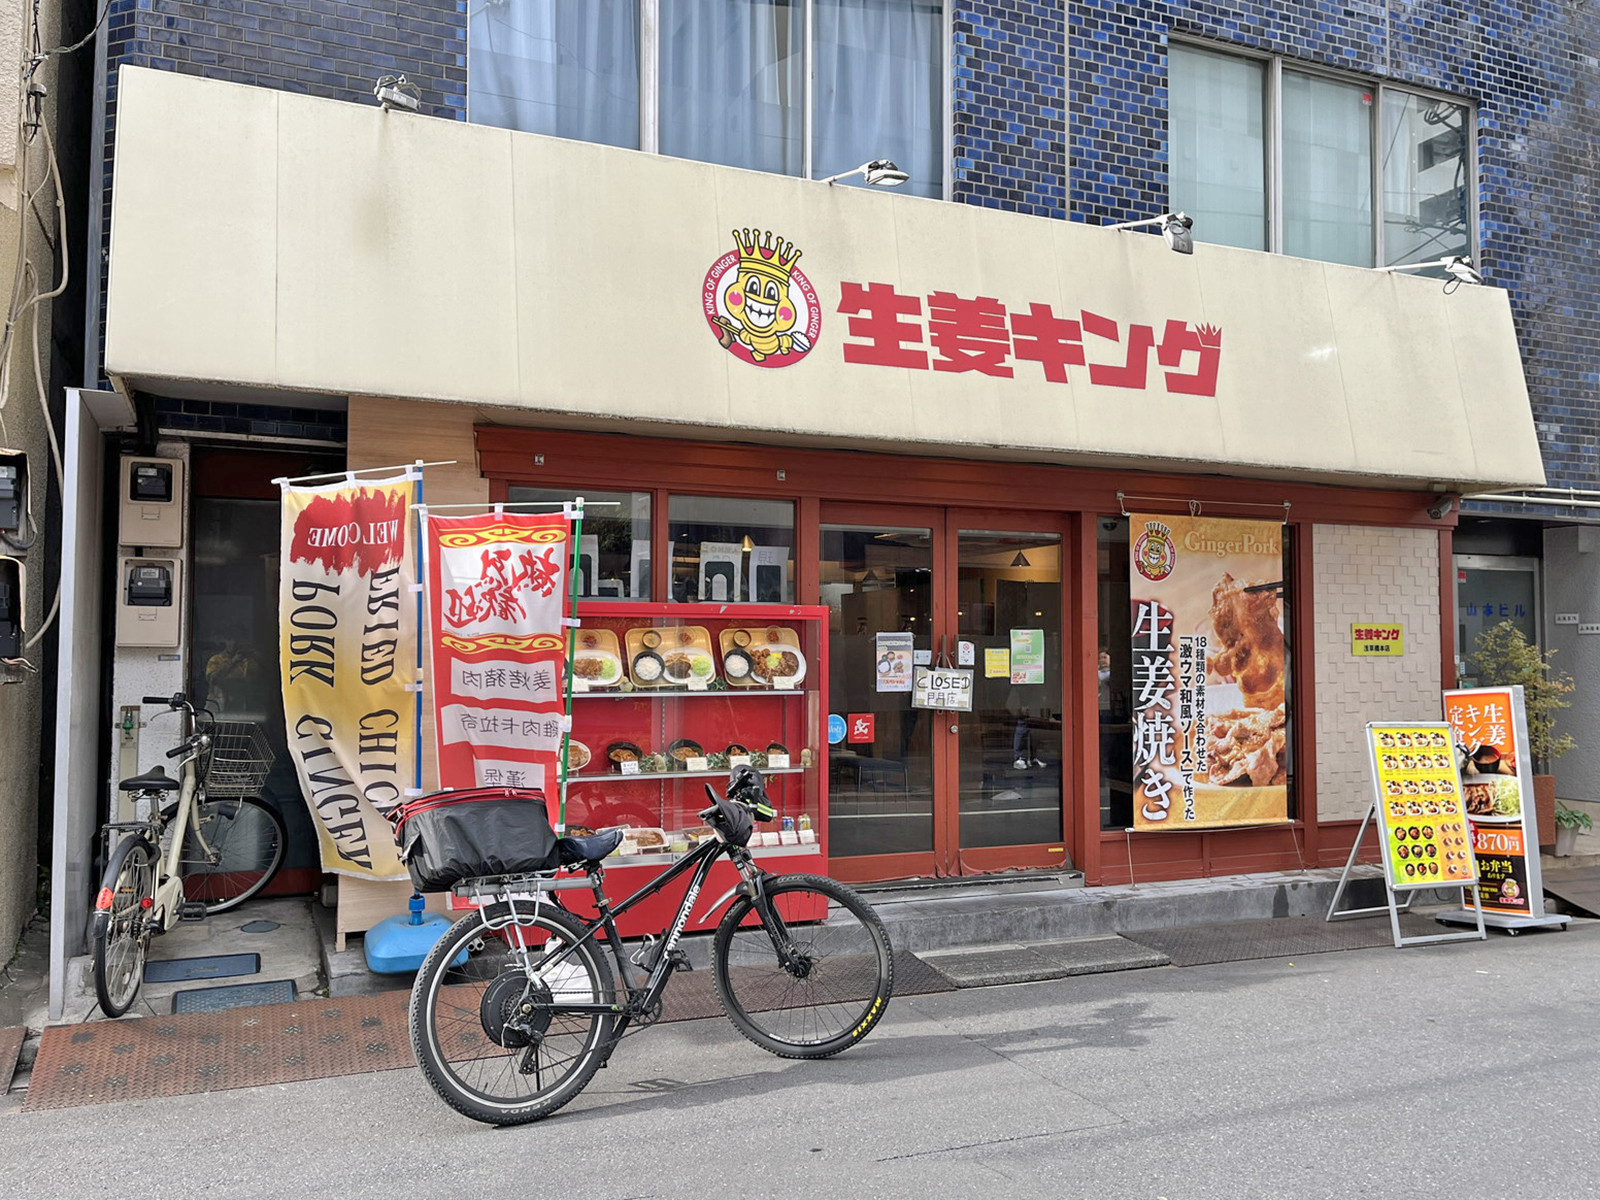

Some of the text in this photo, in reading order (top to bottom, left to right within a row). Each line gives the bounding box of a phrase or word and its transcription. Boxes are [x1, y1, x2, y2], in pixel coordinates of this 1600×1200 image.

[705, 255, 736, 315] KING OF GINGER
[792, 270, 819, 338] KING OF GINGER
[836, 281, 1223, 397] 生姜キング
[1466, 602, 1526, 617] 山本ビル
[1354, 628, 1400, 640] 生姜キング
[916, 674, 971, 690] CLOSED
[1195, 636, 1207, 772] 18種類の素材を合わせた
[1132, 601, 1176, 821] 生姜焼き
[1465, 704, 1485, 756] キング
[1483, 703, 1506, 746] 生姜
[1477, 832, 1520, 851] 870円
[1481, 860, 1513, 873] お弁当
[663, 884, 701, 960] cannondale
[852, 996, 882, 1037] MAXXIS
